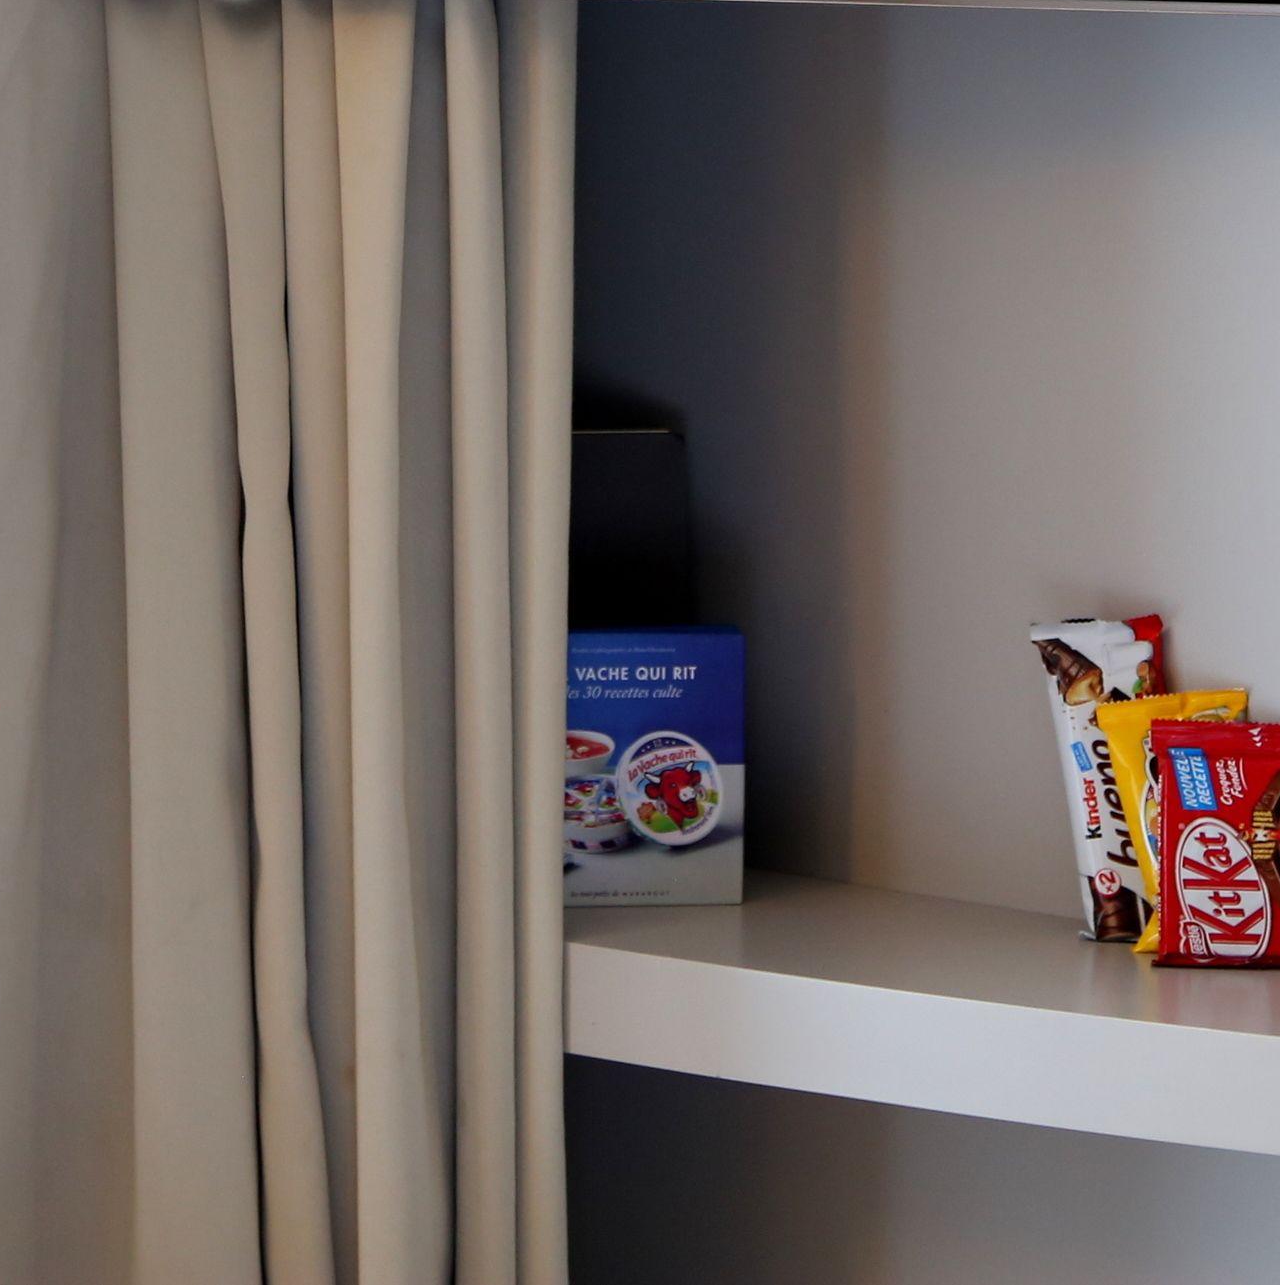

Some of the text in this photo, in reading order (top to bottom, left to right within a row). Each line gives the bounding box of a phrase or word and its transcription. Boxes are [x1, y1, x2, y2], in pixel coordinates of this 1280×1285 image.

[575, 665, 698, 681] VACHE QUI RIT
[583, 685, 602, 699] 30
[604, 688, 650, 699] recettes
[652, 684, 684, 699] culte
[637, 754, 667, 773] Vache
[1172, 749, 1199, 808] NOUVELE
[1188, 756, 1212, 806] RECETTE
[1082, 778, 1102, 840] Kinder
[1182, 831, 1266, 945] KitKat
